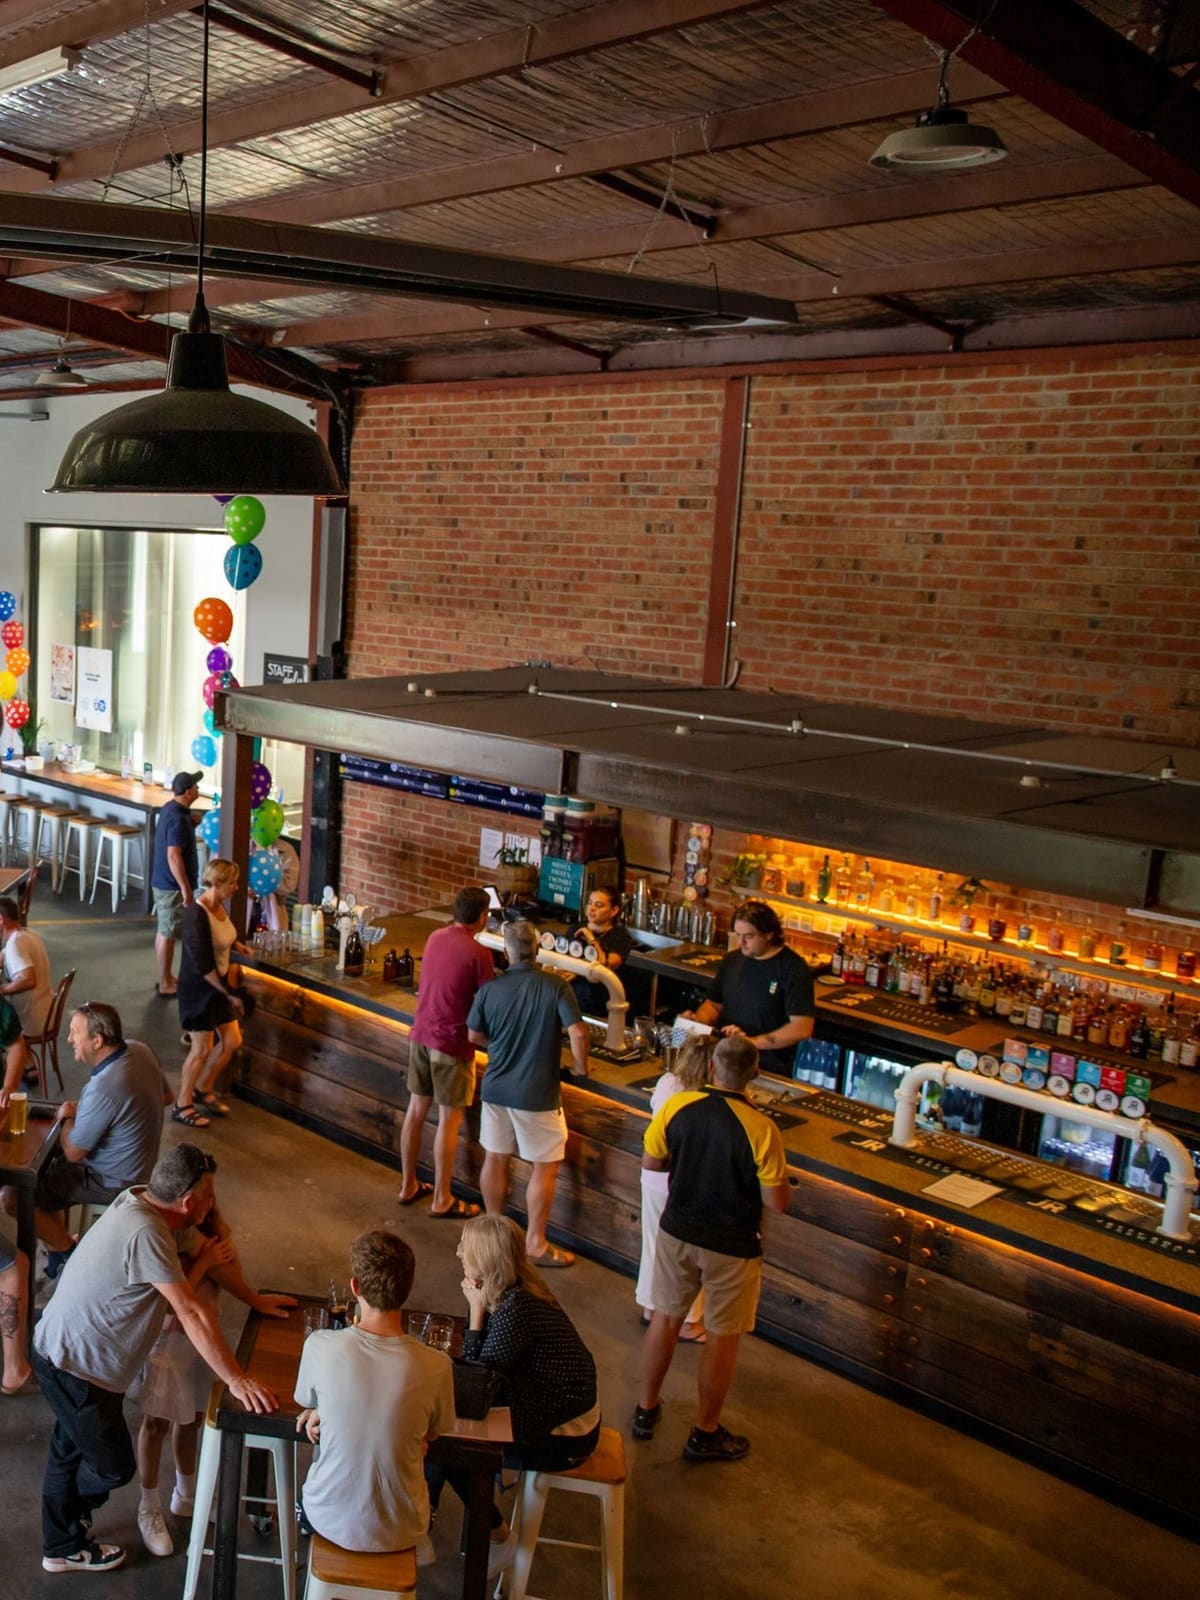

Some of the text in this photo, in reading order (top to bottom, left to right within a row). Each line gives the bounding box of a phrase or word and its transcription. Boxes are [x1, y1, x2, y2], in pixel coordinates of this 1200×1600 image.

[267, 662, 294, 678] STAFF
[850, 1138, 887, 1152] JR
[1026, 1199, 1069, 1215] JR
